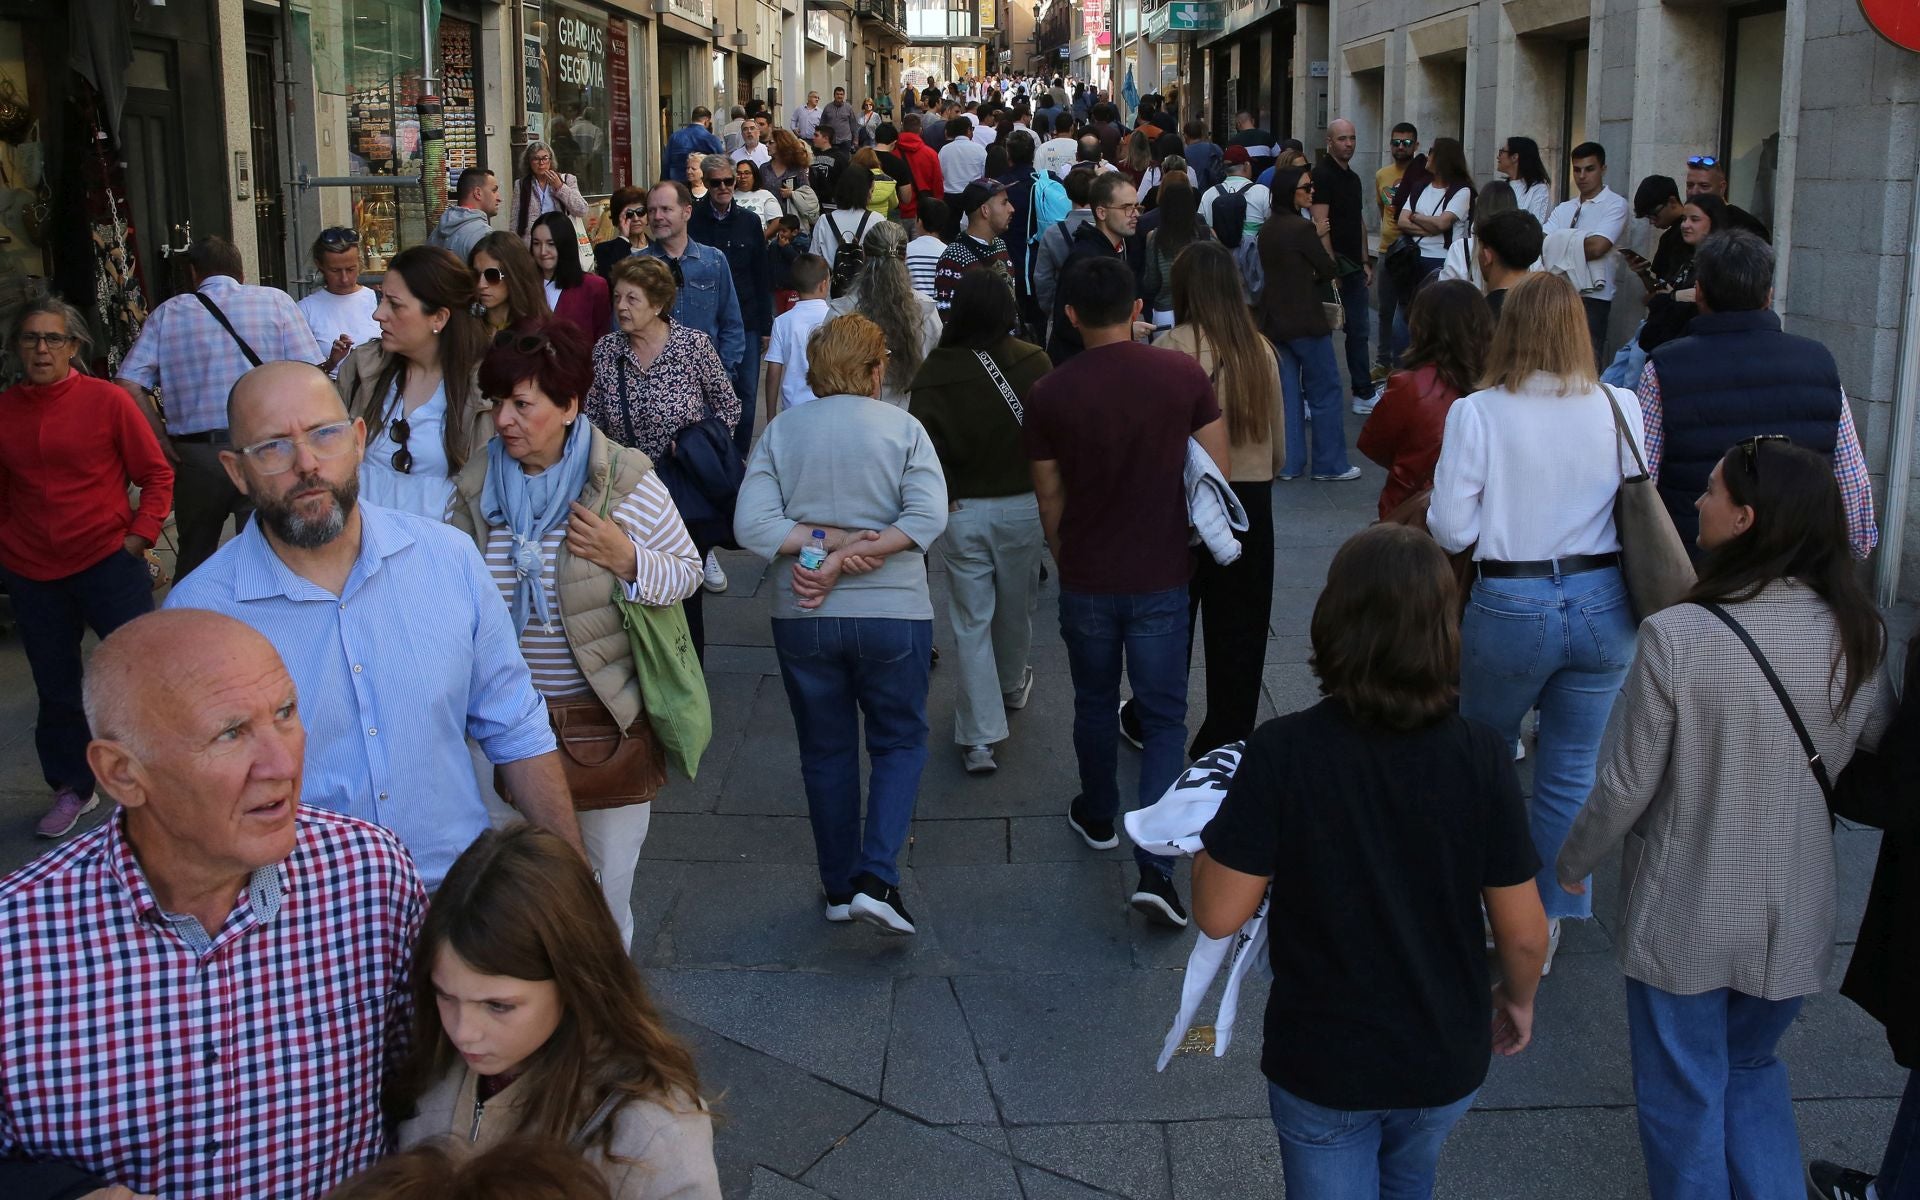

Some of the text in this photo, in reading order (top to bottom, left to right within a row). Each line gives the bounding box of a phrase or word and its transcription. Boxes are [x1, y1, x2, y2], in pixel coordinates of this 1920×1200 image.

[559, 16, 605, 59] GRACIAS,
[560, 53, 605, 88] SEGOVIA
[999, 380, 1016, 402] ASSN.
